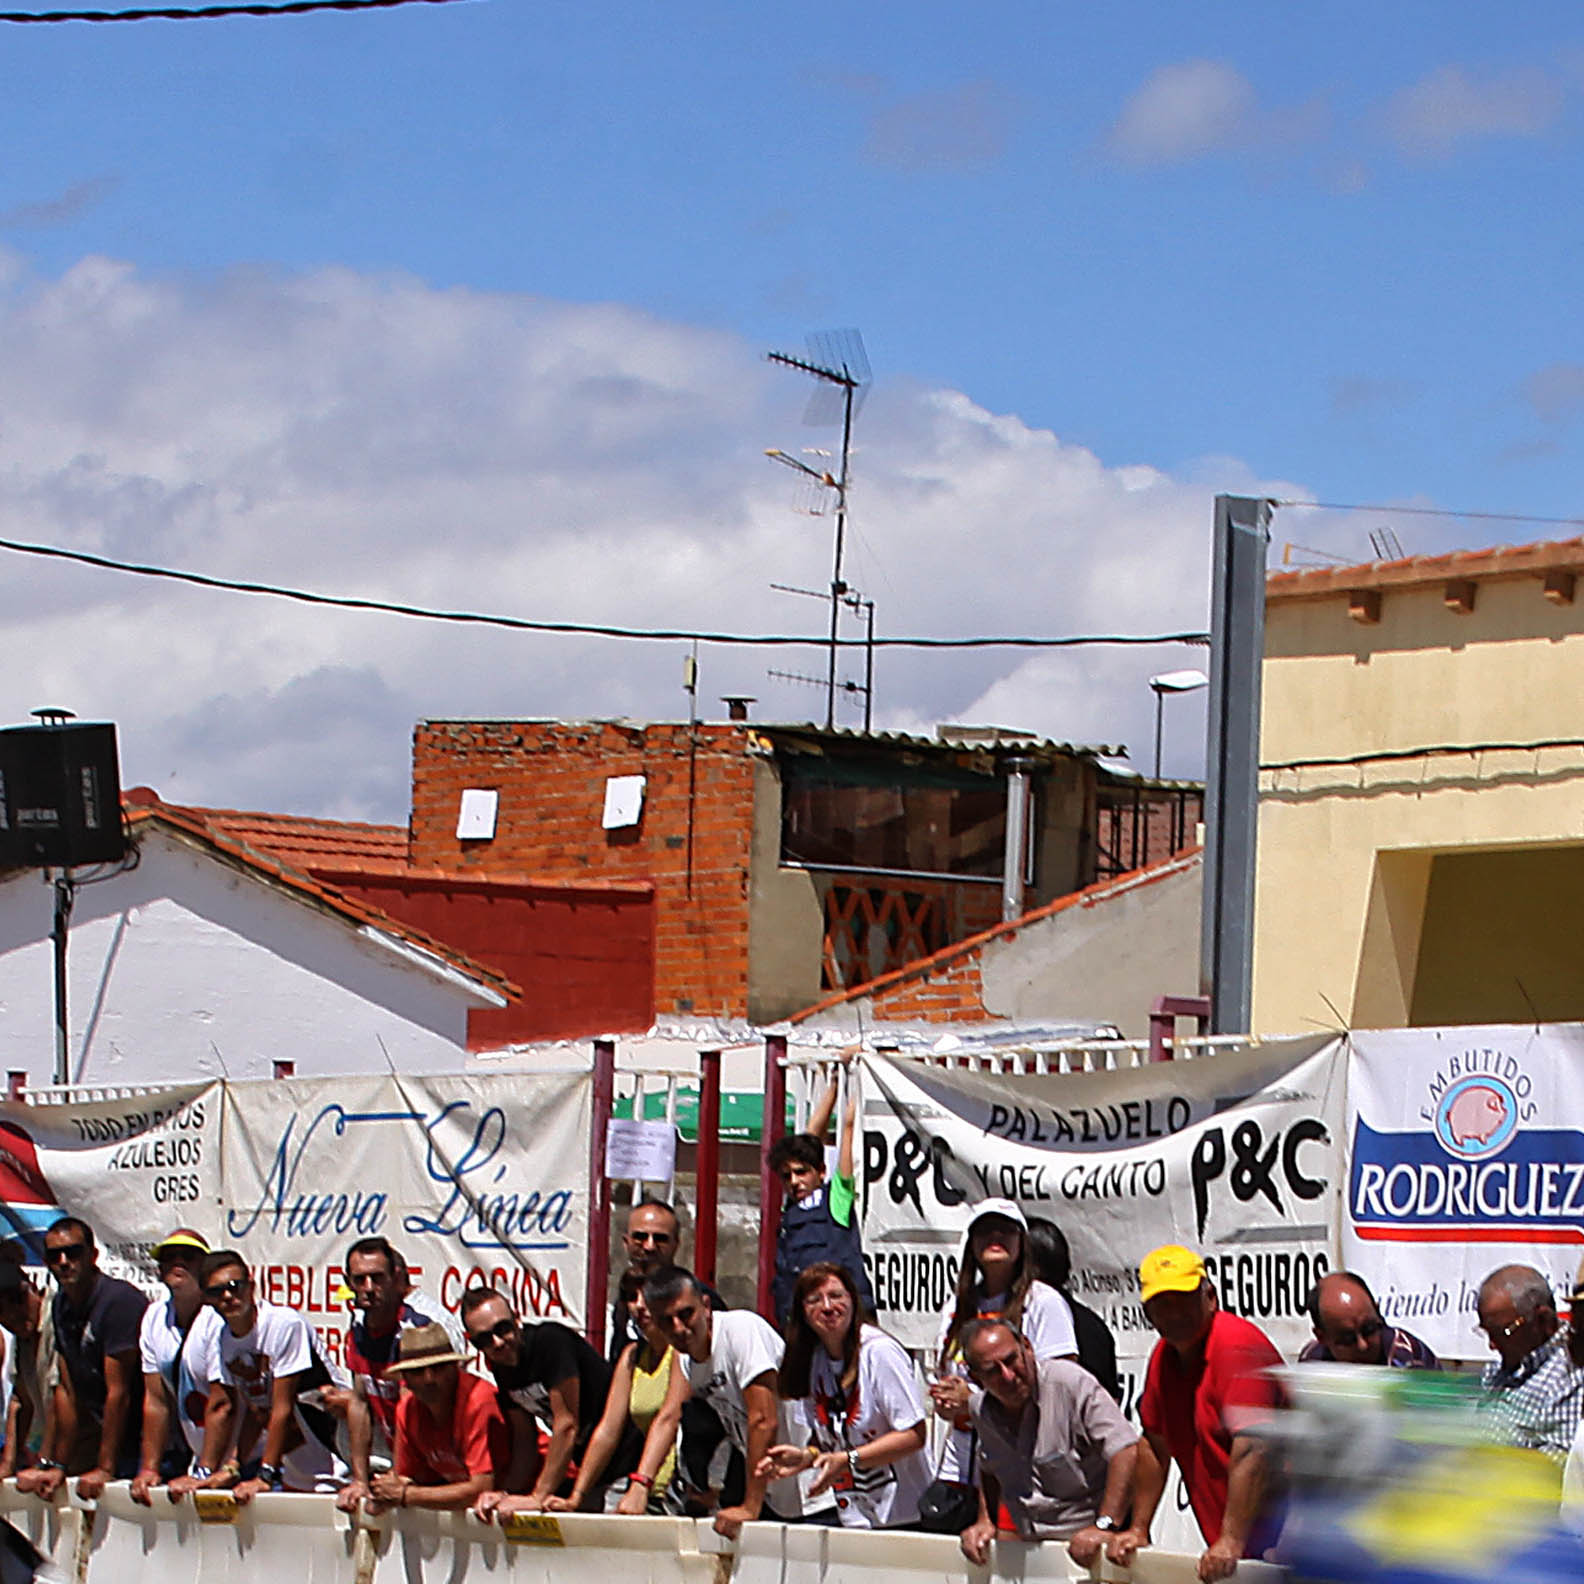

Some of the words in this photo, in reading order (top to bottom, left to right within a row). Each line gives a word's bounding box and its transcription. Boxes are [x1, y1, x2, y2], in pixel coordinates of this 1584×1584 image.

[1420, 1049, 1538, 1122] EMBUTIDOS
[71, 1117, 124, 1142] TODO
[983, 1096, 1191, 1143] PALAZUELO
[108, 1138, 203, 1170] AZULEJOS
[228, 1104, 392, 1239] Nueva
[974, 1165, 993, 1196] Y
[999, 1163, 1052, 1200] DEL
[1060, 1158, 1167, 1200] CANTO
[1191, 1119, 1332, 1244] P&C
[153, 1174, 200, 1203] GRES
[863, 1252, 958, 1315] SEGUROS
[1204, 1253, 1329, 1319] SEGUROS
